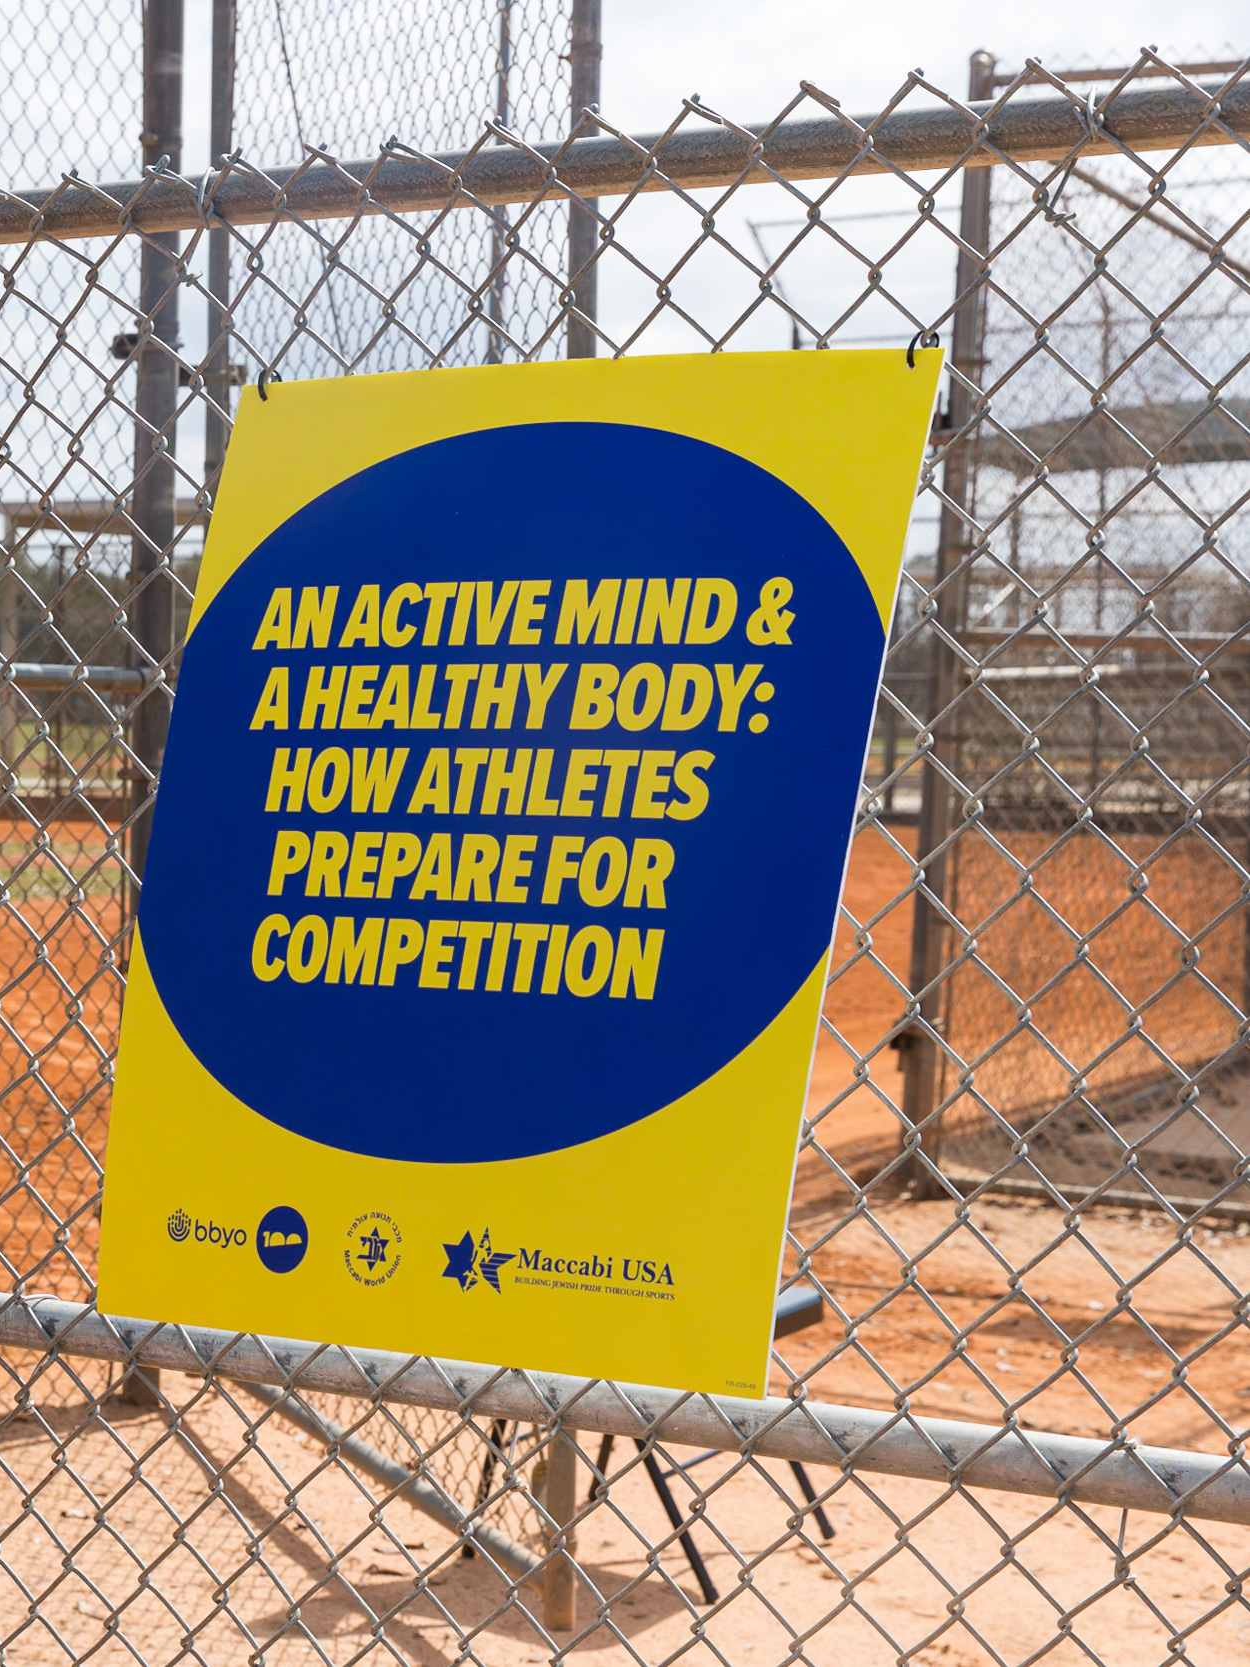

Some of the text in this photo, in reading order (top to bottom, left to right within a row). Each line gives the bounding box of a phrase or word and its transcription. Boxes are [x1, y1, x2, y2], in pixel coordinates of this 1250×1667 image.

[252, 577, 795, 650] AN ACTIVE MIND &
[250, 662, 776, 733] A HEALTHY BODY:
[265, 747, 715, 821] HOW ATHLETES
[267, 830, 675, 909] PREPARE FOR
[251, 914, 665, 1000] COMPETITION
[194, 1219, 247, 1249] bbyo
[344, 1250, 402, 1287] Maccabi World Union
[517, 1248, 675, 1286] Maccabi USA
[515, 1276, 676, 1301] BUILDING JEWISH PRIDE THROUGH SPORTS
